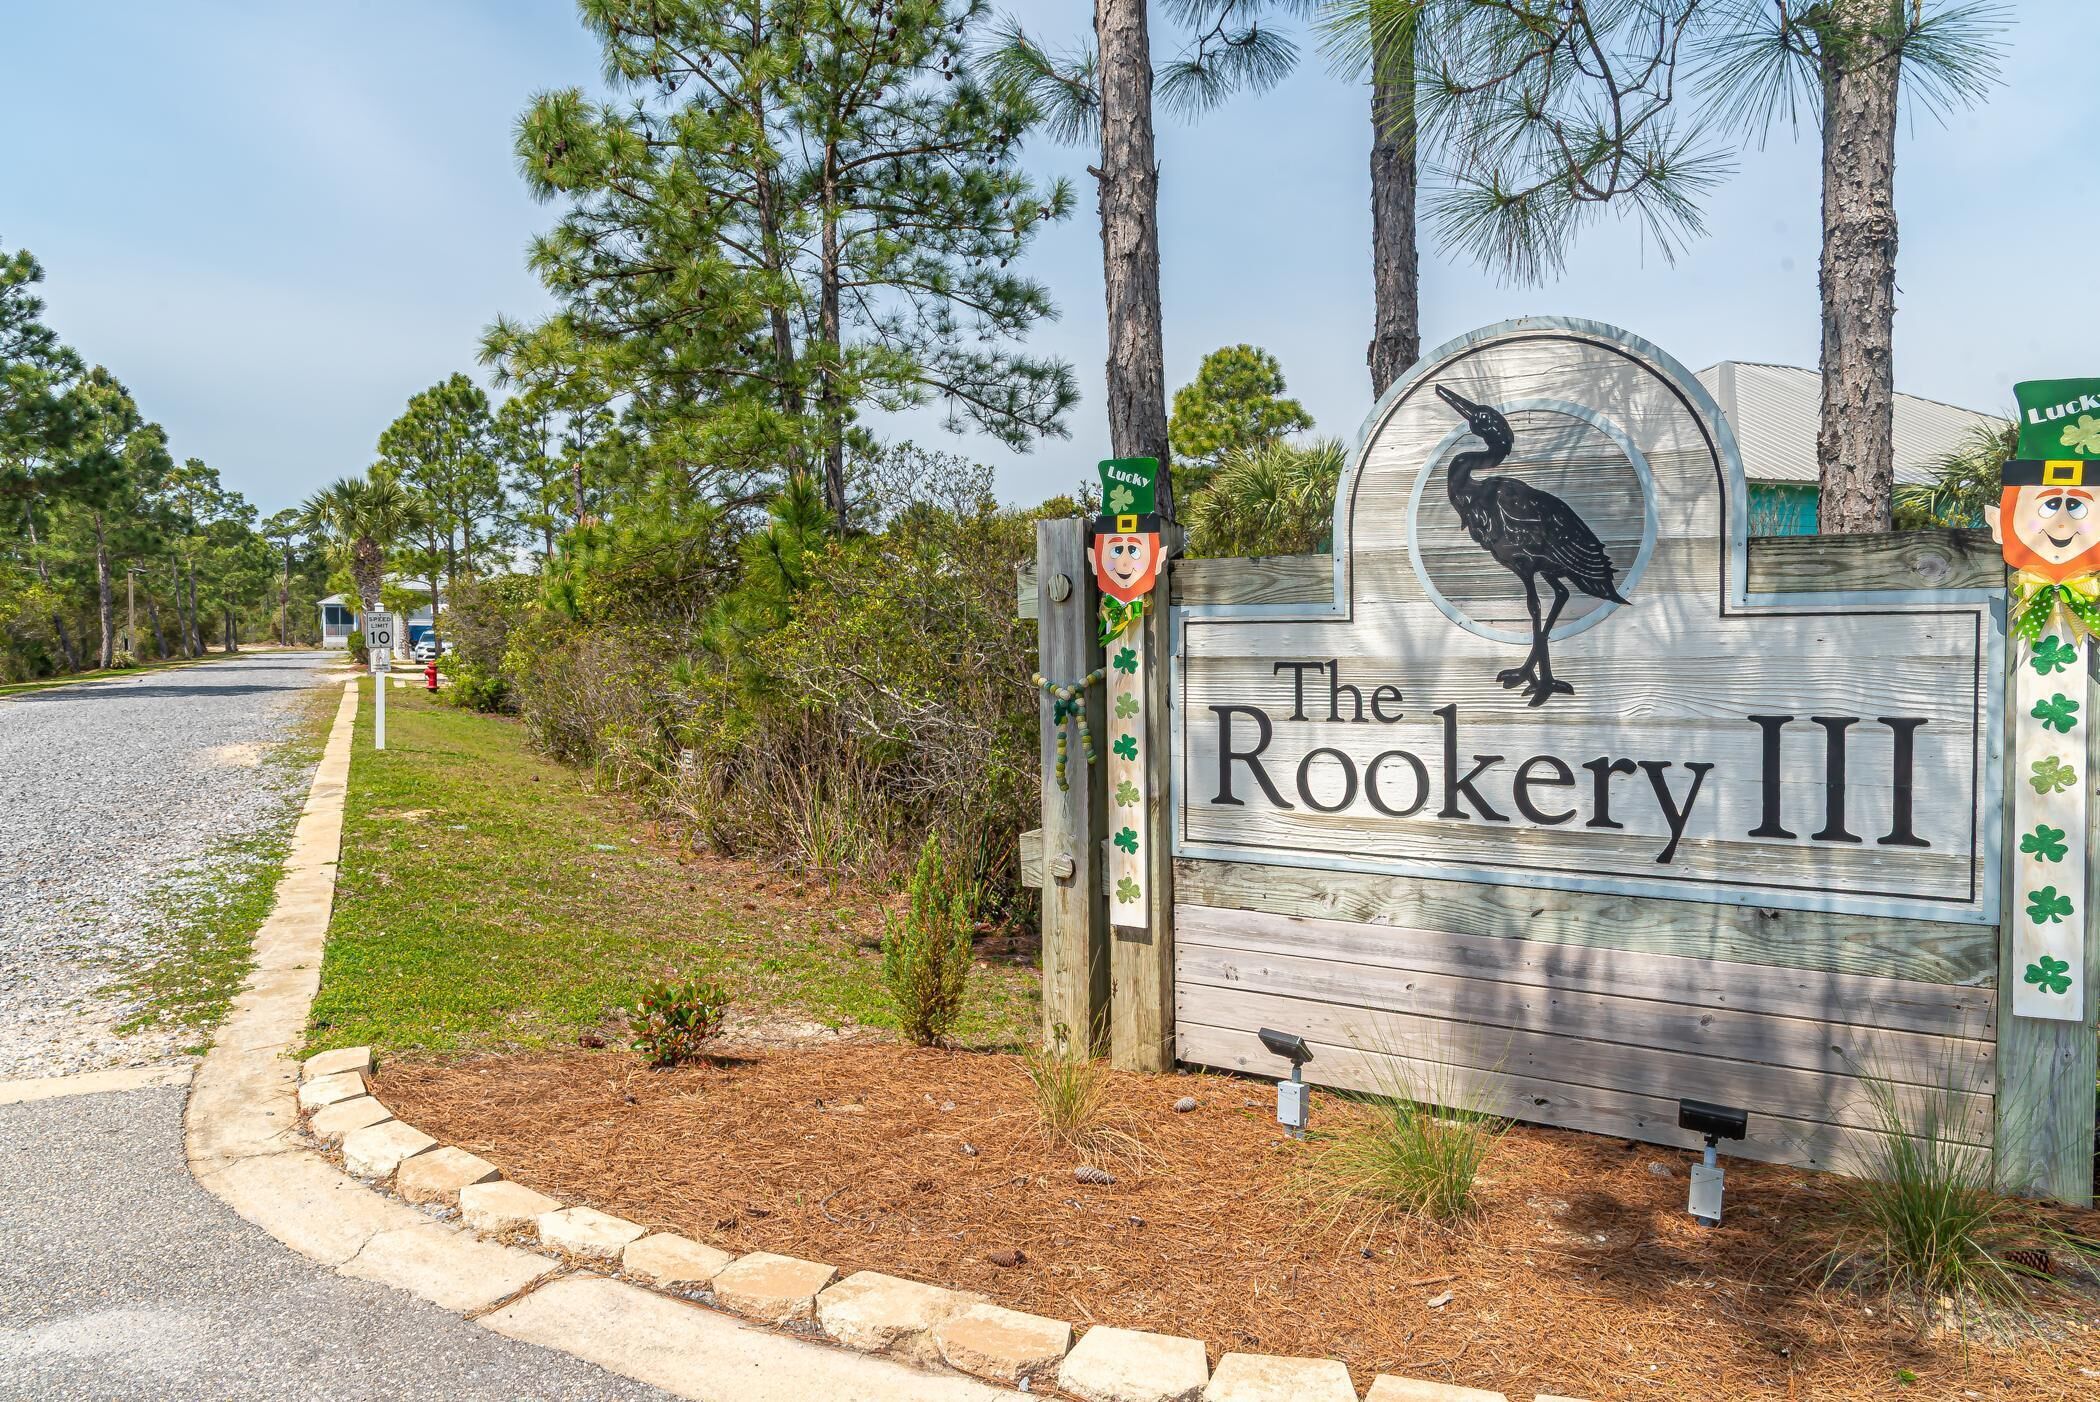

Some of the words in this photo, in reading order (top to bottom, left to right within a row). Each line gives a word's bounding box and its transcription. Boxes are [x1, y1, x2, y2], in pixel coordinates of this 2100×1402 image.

[2027, 394, 2100, 425] Luck
[1107, 465, 1151, 488] Lucky
[370, 631, 390, 644] 10
[1273, 658, 1404, 724] The
[1208, 702, 1715, 864] Rookery
[1747, 714, 1931, 848] III
